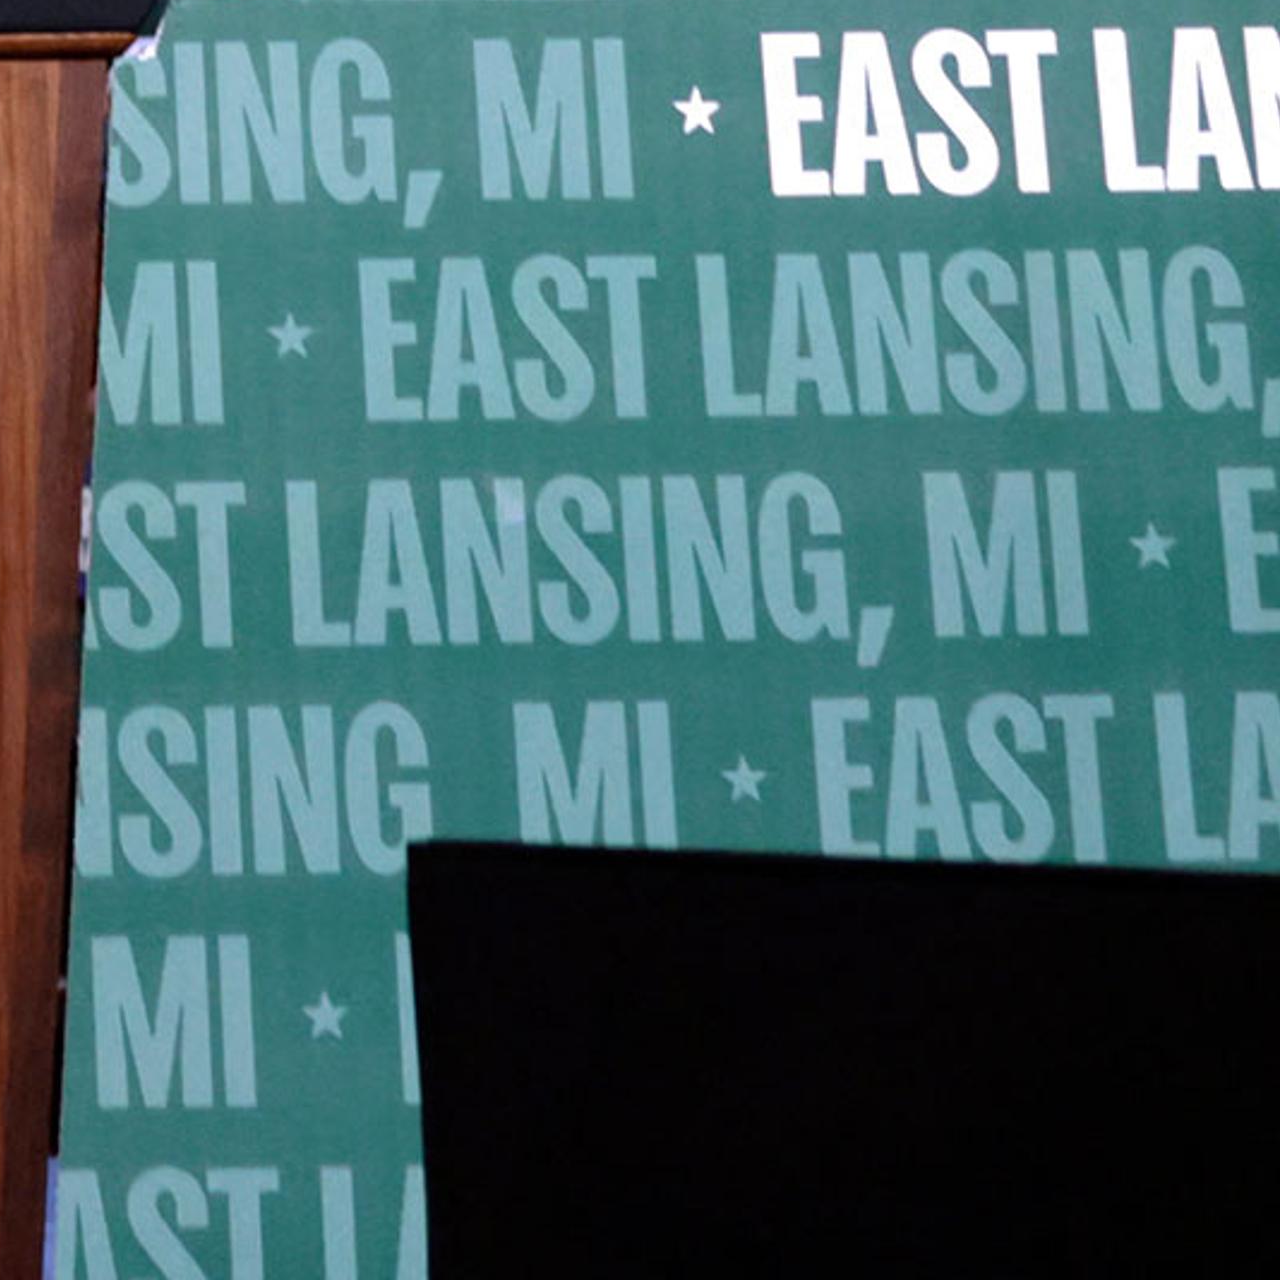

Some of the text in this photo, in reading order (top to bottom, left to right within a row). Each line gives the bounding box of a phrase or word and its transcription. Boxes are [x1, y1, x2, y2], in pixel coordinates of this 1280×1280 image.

[107, 37, 444, 229] SING,
[471, 36, 635, 201] MI
[758, 25, 1062, 199] EAST
[97, 245, 1280, 439] MI EAST LANSING,
[83, 466, 1280, 668] ST LANSING, MI E
[512, 699, 679, 850] MI
[810, 692, 1114, 864] EAST
[91, 934, 258, 1110] MI
